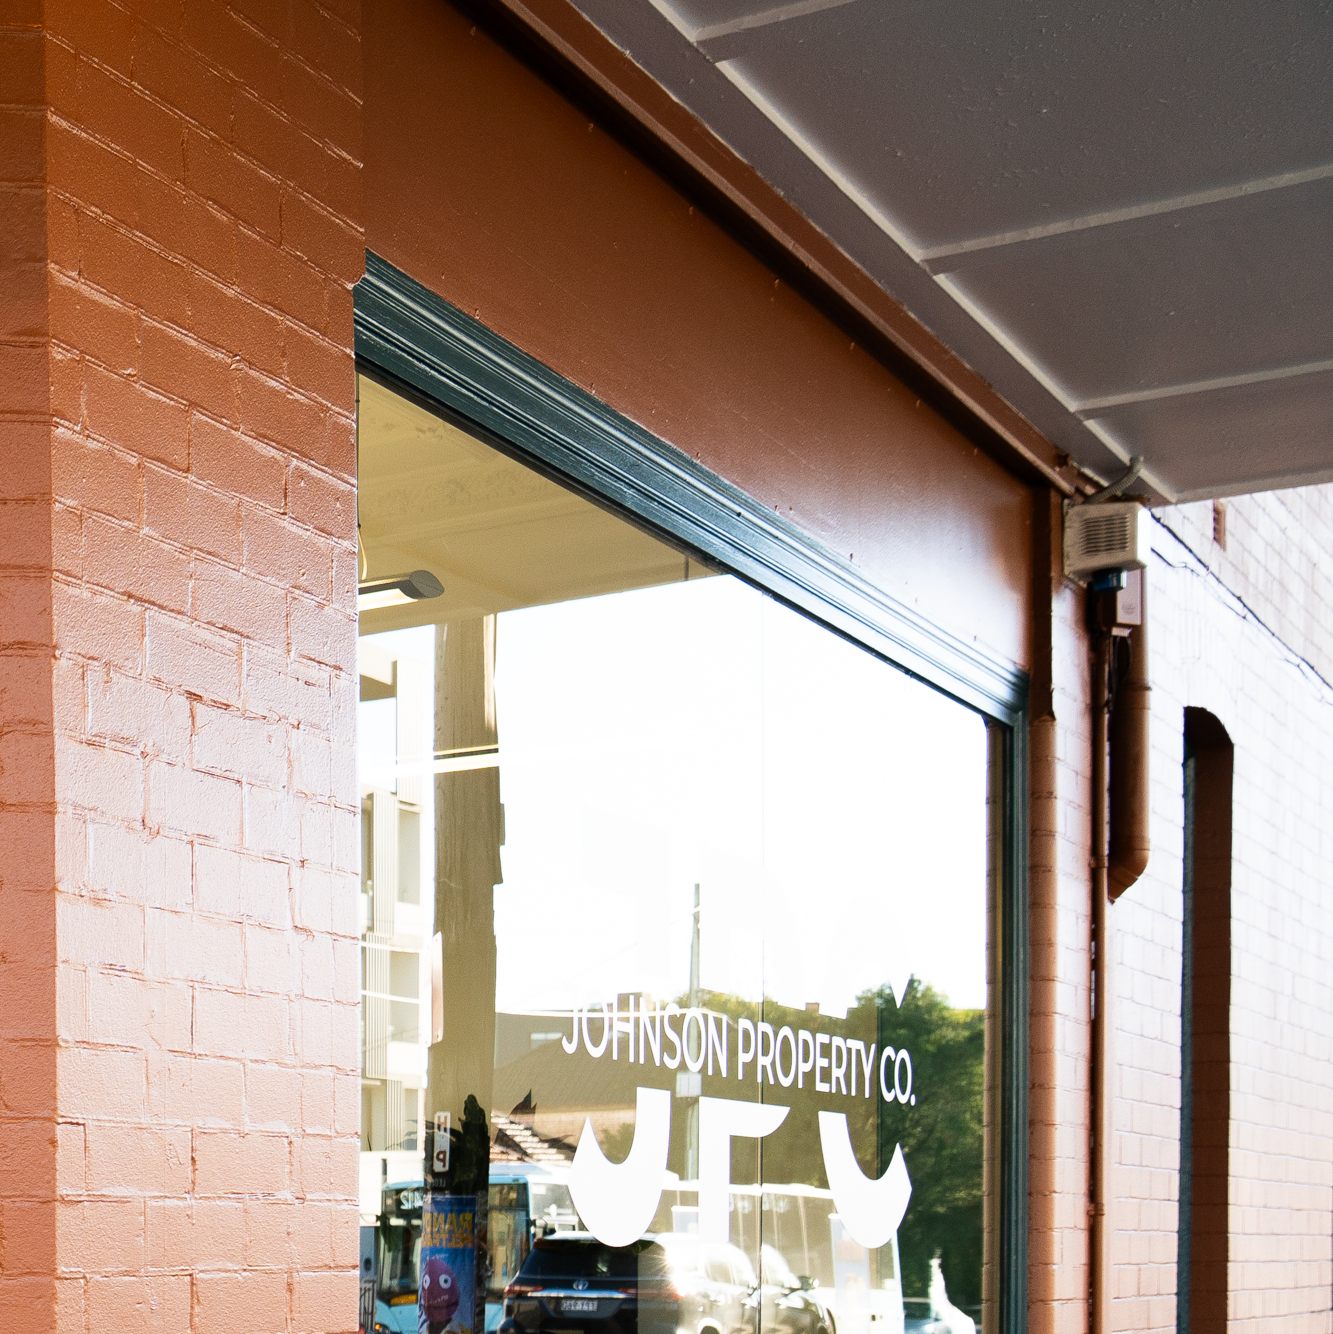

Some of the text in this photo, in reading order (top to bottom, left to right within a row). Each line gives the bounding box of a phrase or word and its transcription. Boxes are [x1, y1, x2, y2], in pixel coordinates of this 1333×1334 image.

[561, 994, 917, 1107] JOHNSON PROPERTY CO.
